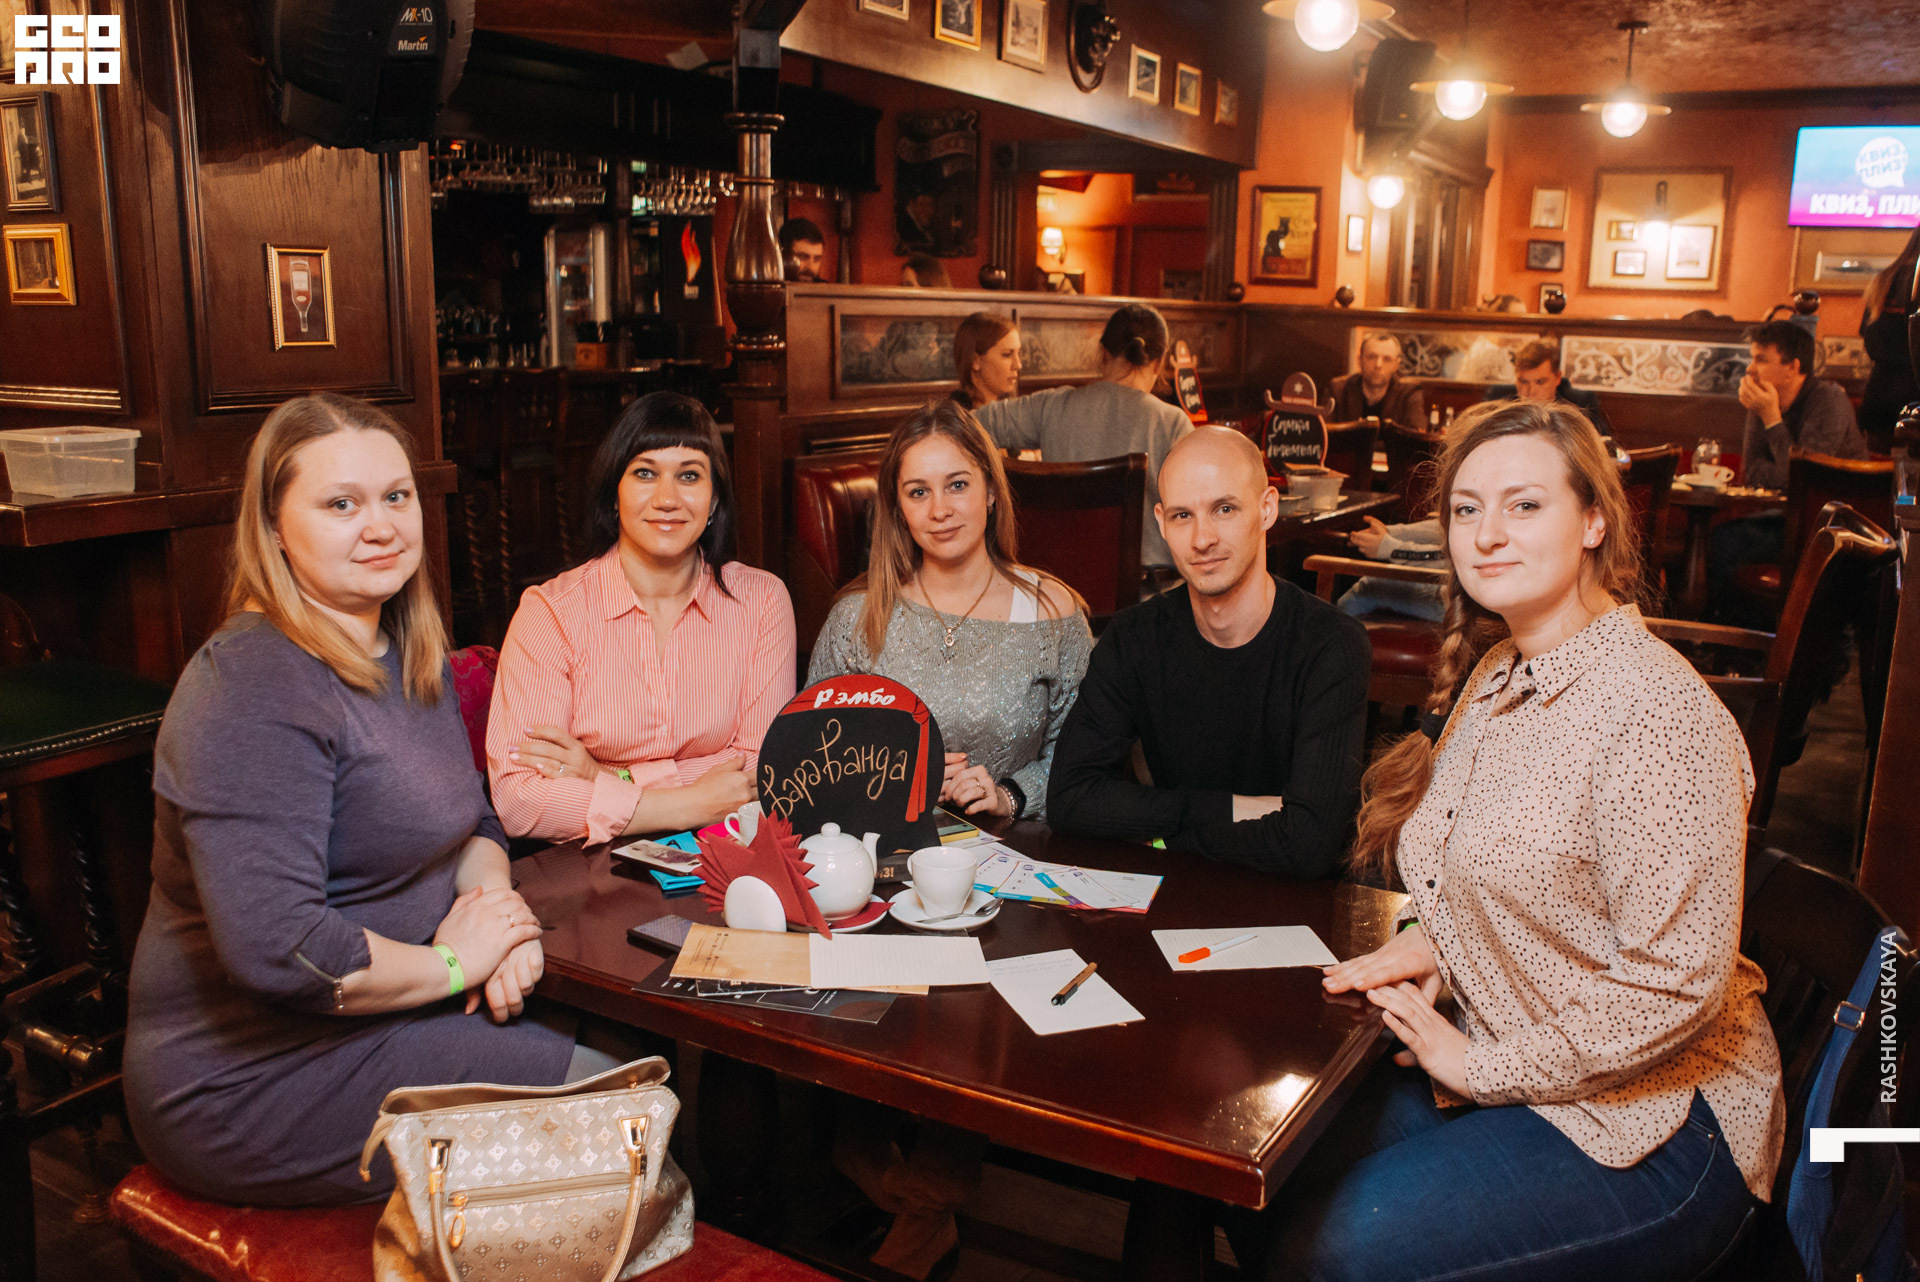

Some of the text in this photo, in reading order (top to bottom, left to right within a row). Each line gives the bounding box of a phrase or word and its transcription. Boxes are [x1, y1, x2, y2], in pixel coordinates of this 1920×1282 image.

[400, 7, 433, 23] MX-10
[398, 36, 428, 51] Martin
[1809, 193, 1875, 218] КВИЗ,
